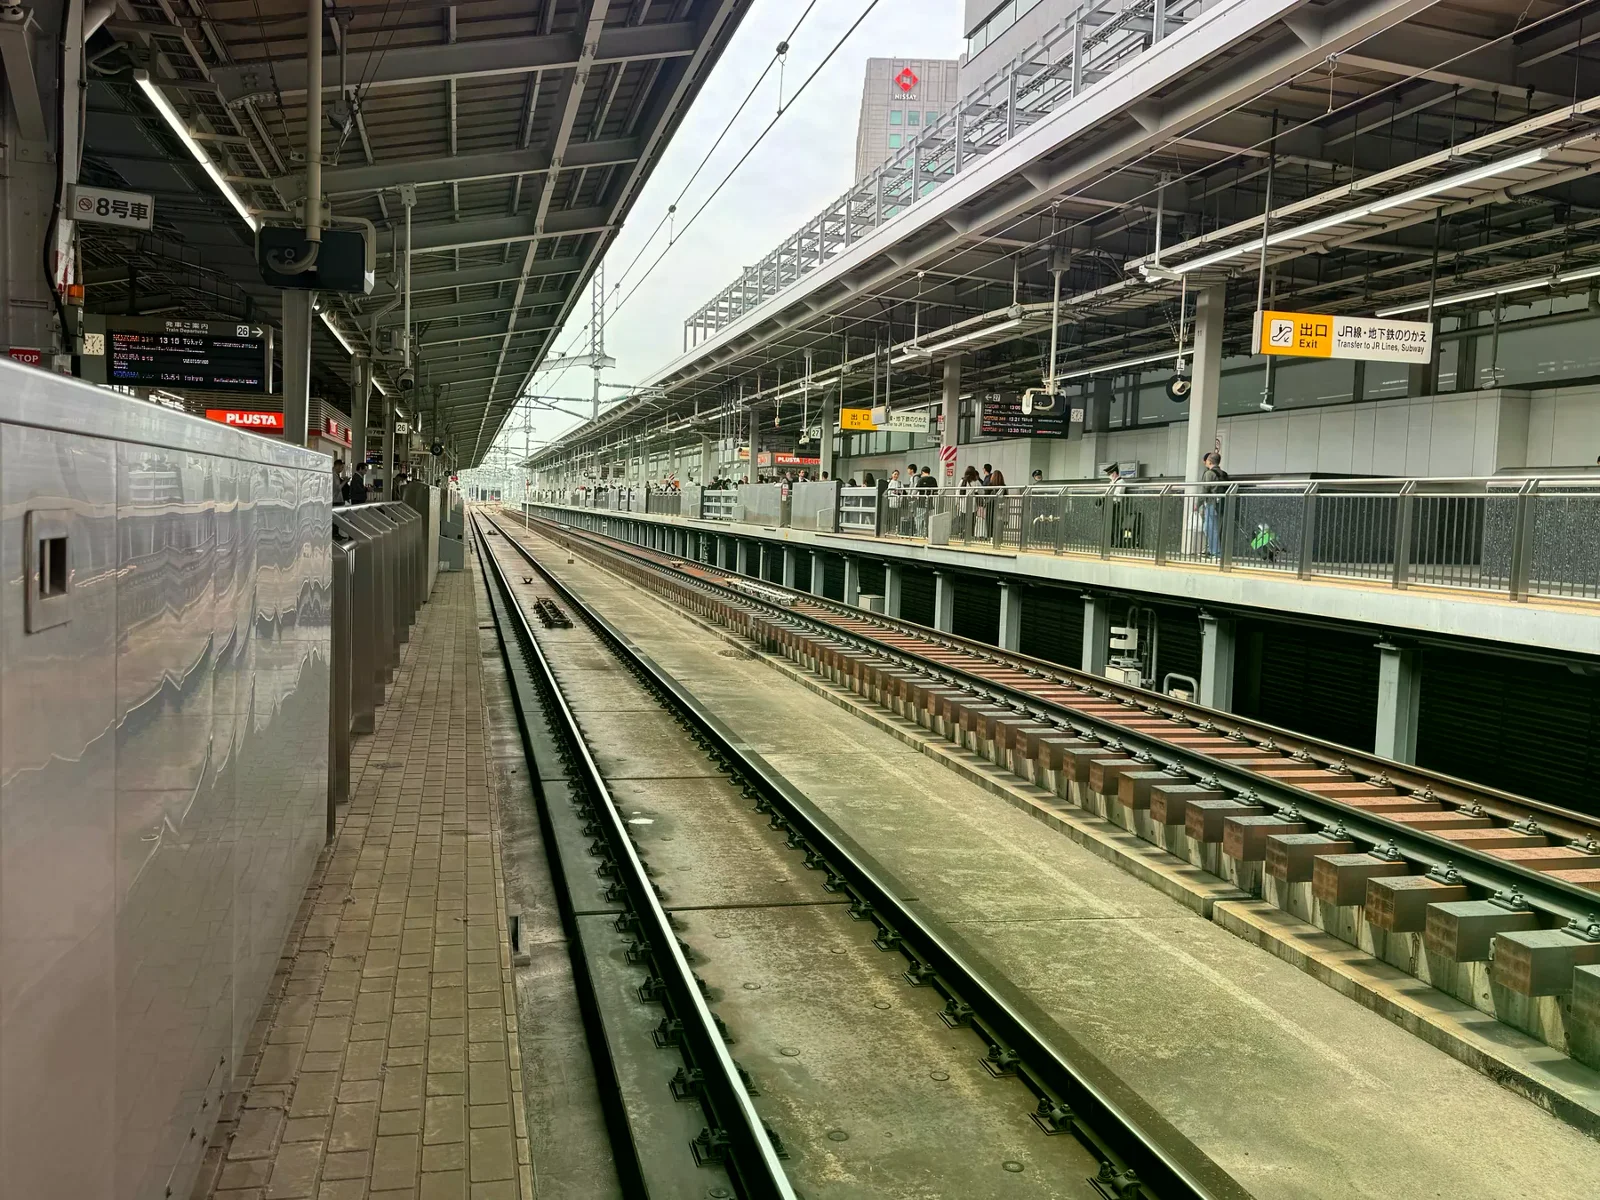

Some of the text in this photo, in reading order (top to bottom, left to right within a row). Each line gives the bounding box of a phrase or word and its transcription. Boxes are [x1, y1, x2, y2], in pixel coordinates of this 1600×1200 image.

[96, 197, 149, 221] 8号車
[238, 326, 249, 337] 26
[1300, 322, 1328, 338] 出口
[1337, 325, 1427, 343] JR線・地下鉄のりかえ
[1299, 338, 1318, 349] Exit
[1337, 339, 1425, 355] Transfer to JR Lines, Subway
[11, 353, 39, 363] STOP
[226, 412, 277, 426] PLUSTA
[850, 413, 870, 421] 出口
[397, 424, 406, 432] 26
[777, 456, 801, 464] PLUSTA
